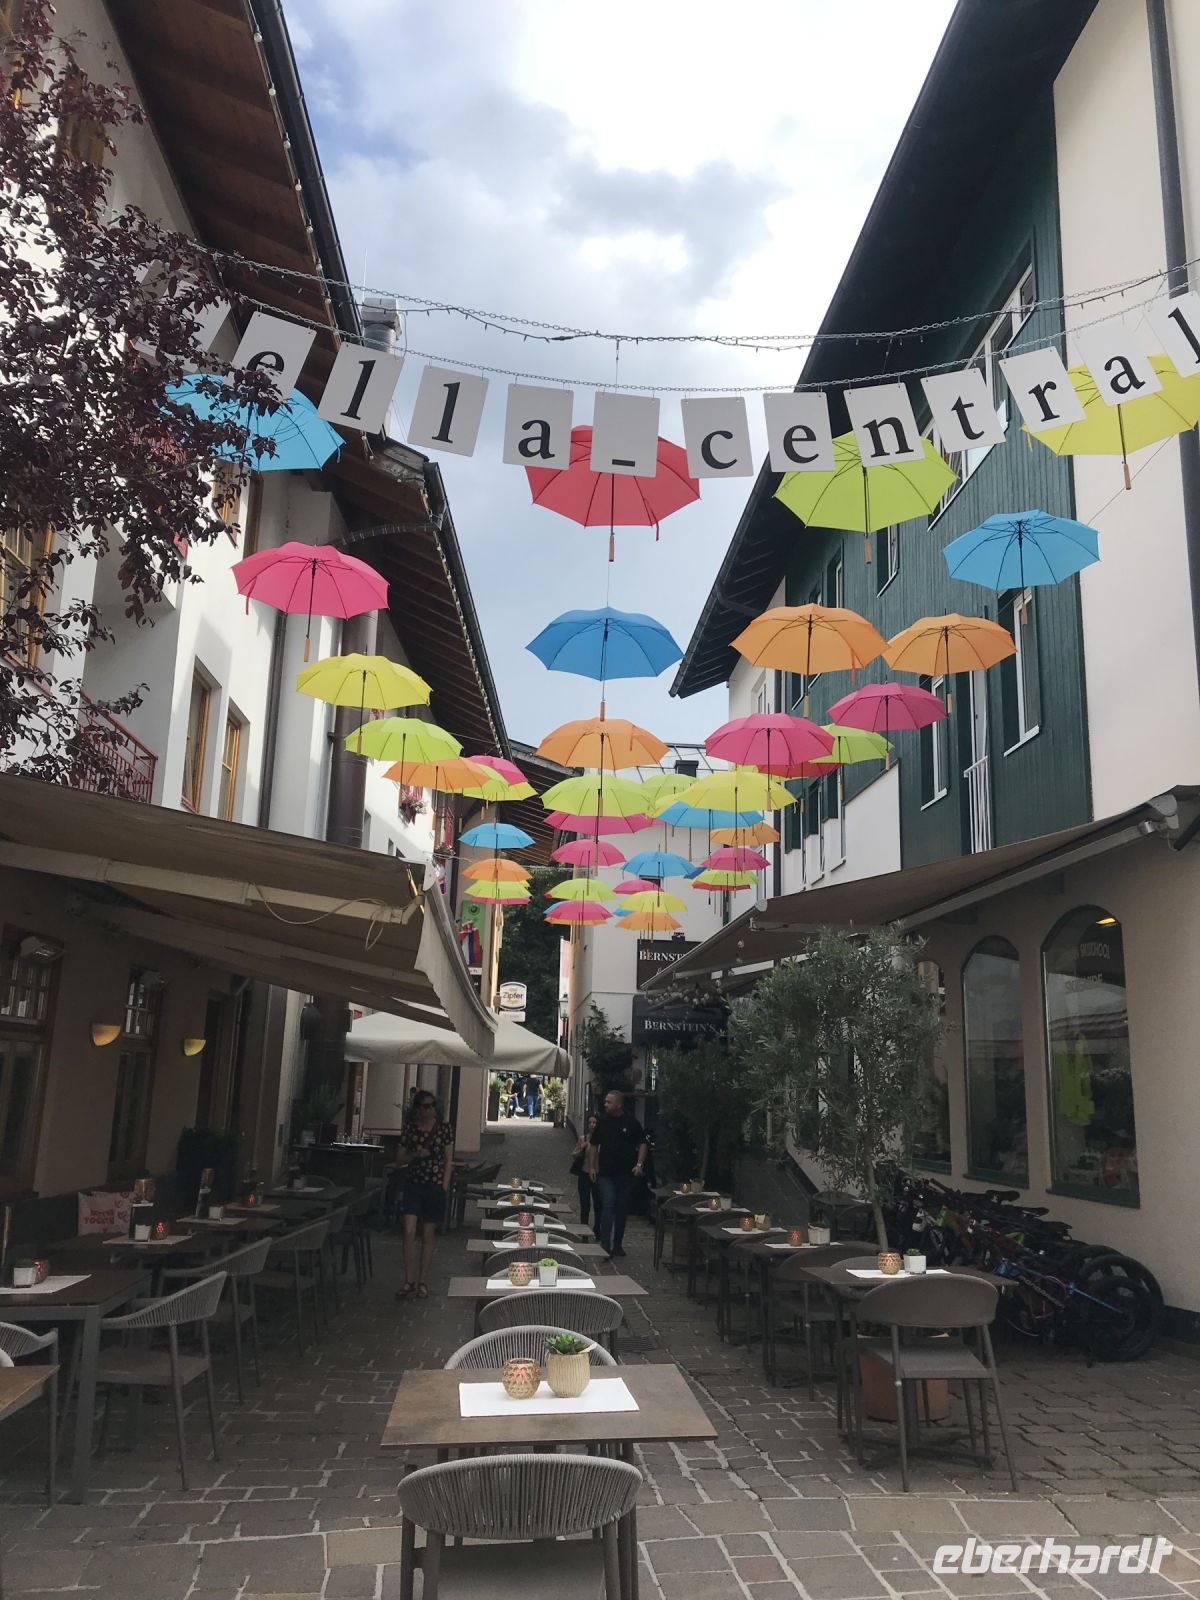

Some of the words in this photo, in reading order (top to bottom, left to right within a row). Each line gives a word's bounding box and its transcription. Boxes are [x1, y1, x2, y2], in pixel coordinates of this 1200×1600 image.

[639, 950, 686, 961] BERNST
[502, 991, 525, 1001] Zipfer
[644, 1019, 716, 1032] BERNSTEIN'S
